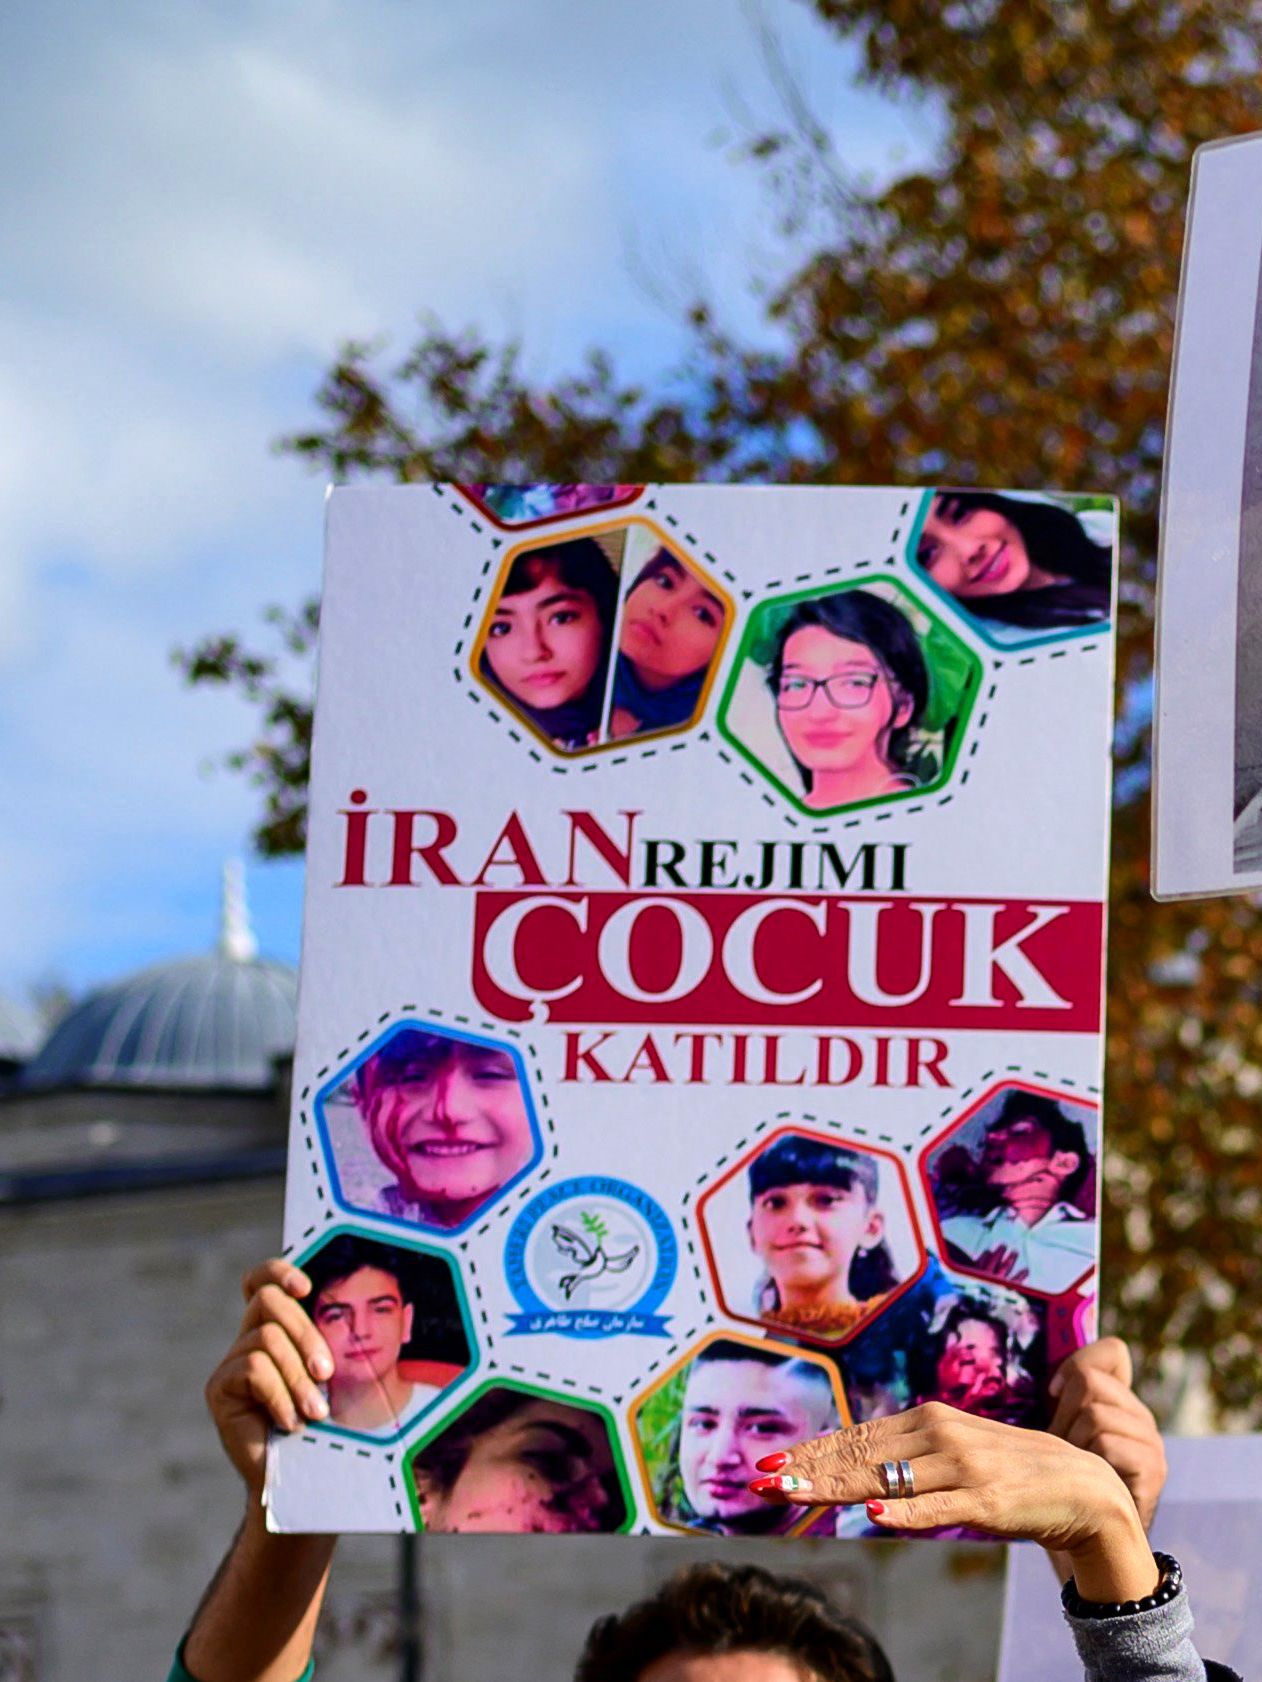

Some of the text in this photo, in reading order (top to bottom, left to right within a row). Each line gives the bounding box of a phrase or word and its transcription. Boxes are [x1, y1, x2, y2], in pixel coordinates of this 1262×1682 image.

[333, 789, 914, 891] İRAN REJIMI
[482, 895, 1072, 1022] ÇOCUK
[561, 1031, 954, 1088] KATILDIR
